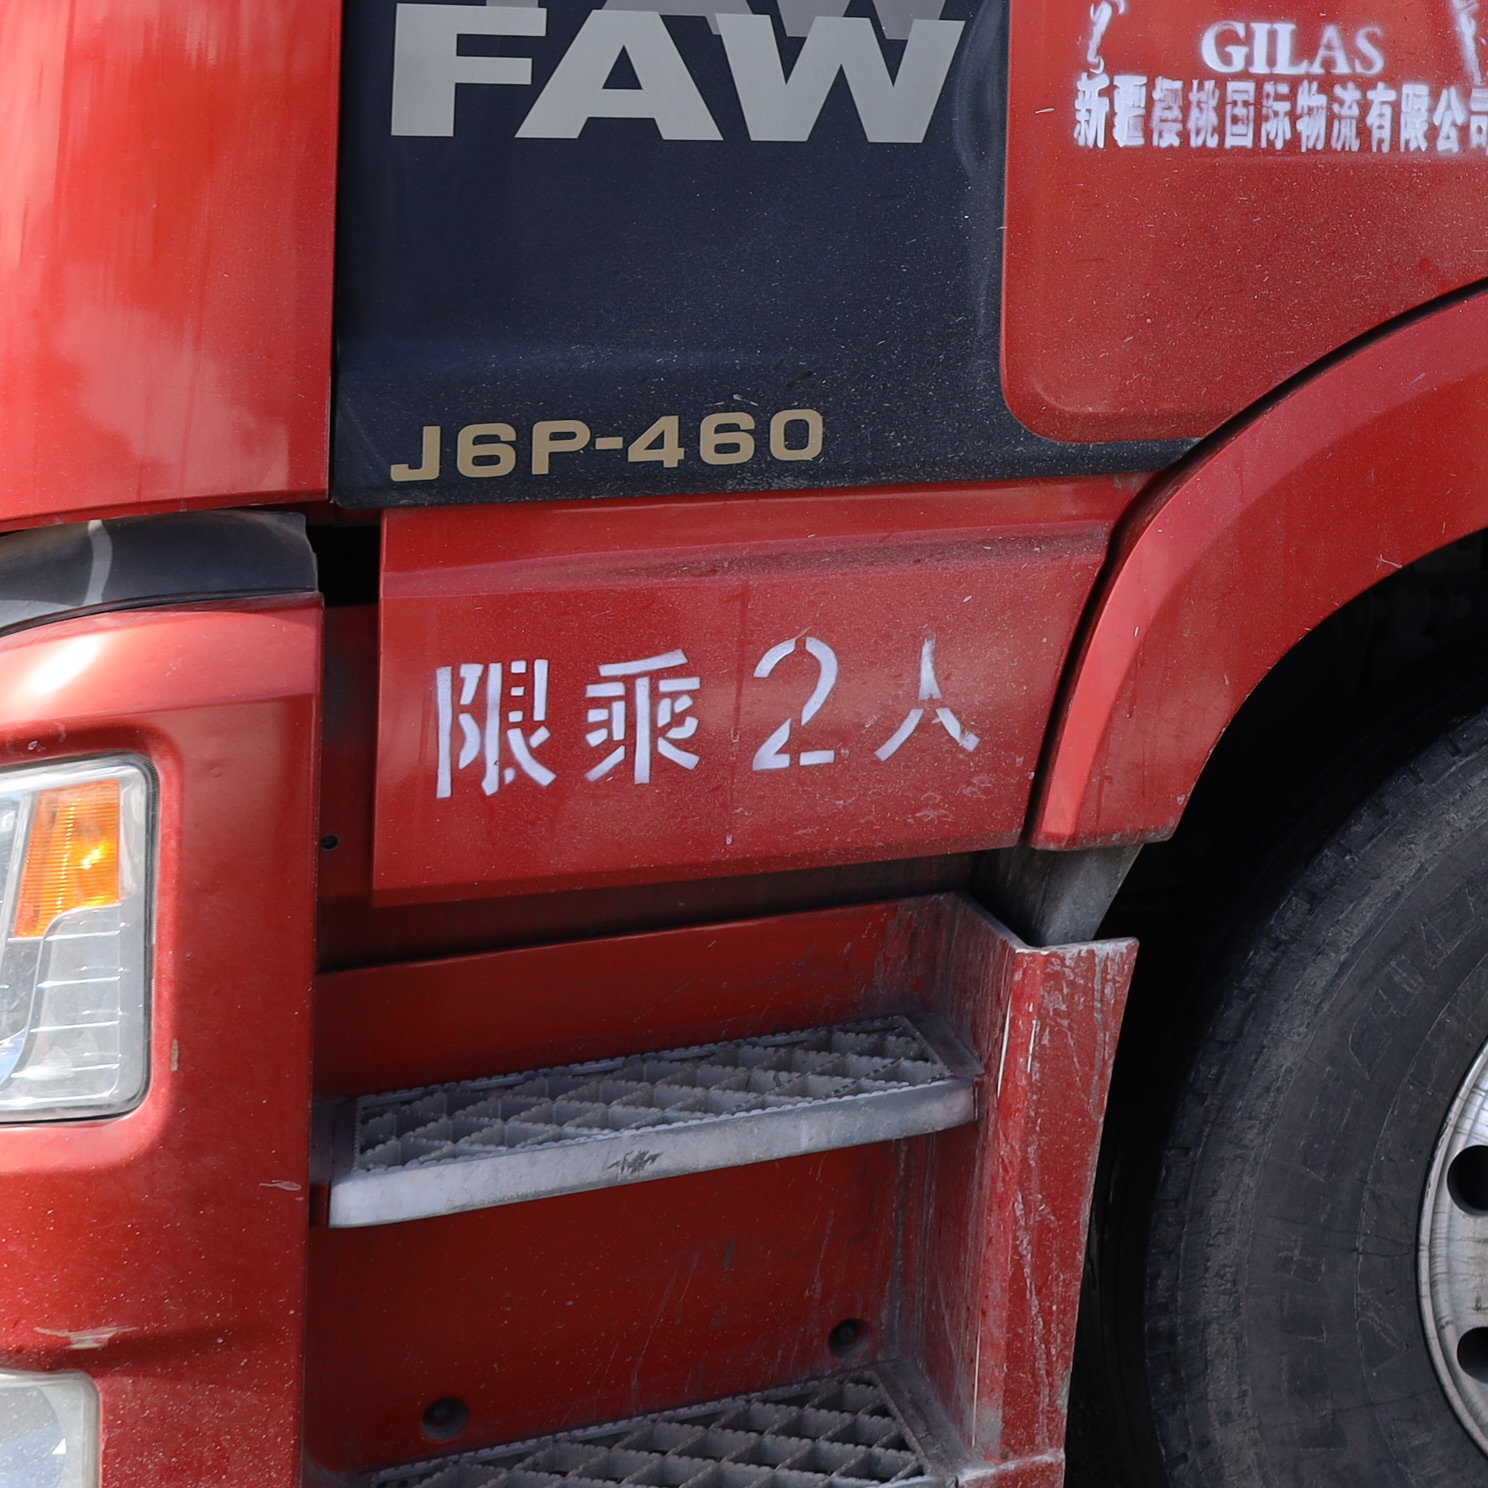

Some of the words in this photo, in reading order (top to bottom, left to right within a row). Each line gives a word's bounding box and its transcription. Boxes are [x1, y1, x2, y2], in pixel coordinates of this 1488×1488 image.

[391, 3, 965, 144] FAW
[1201, 22, 1384, 76] GILAS
[390, 409, 824, 482] J6P-460
